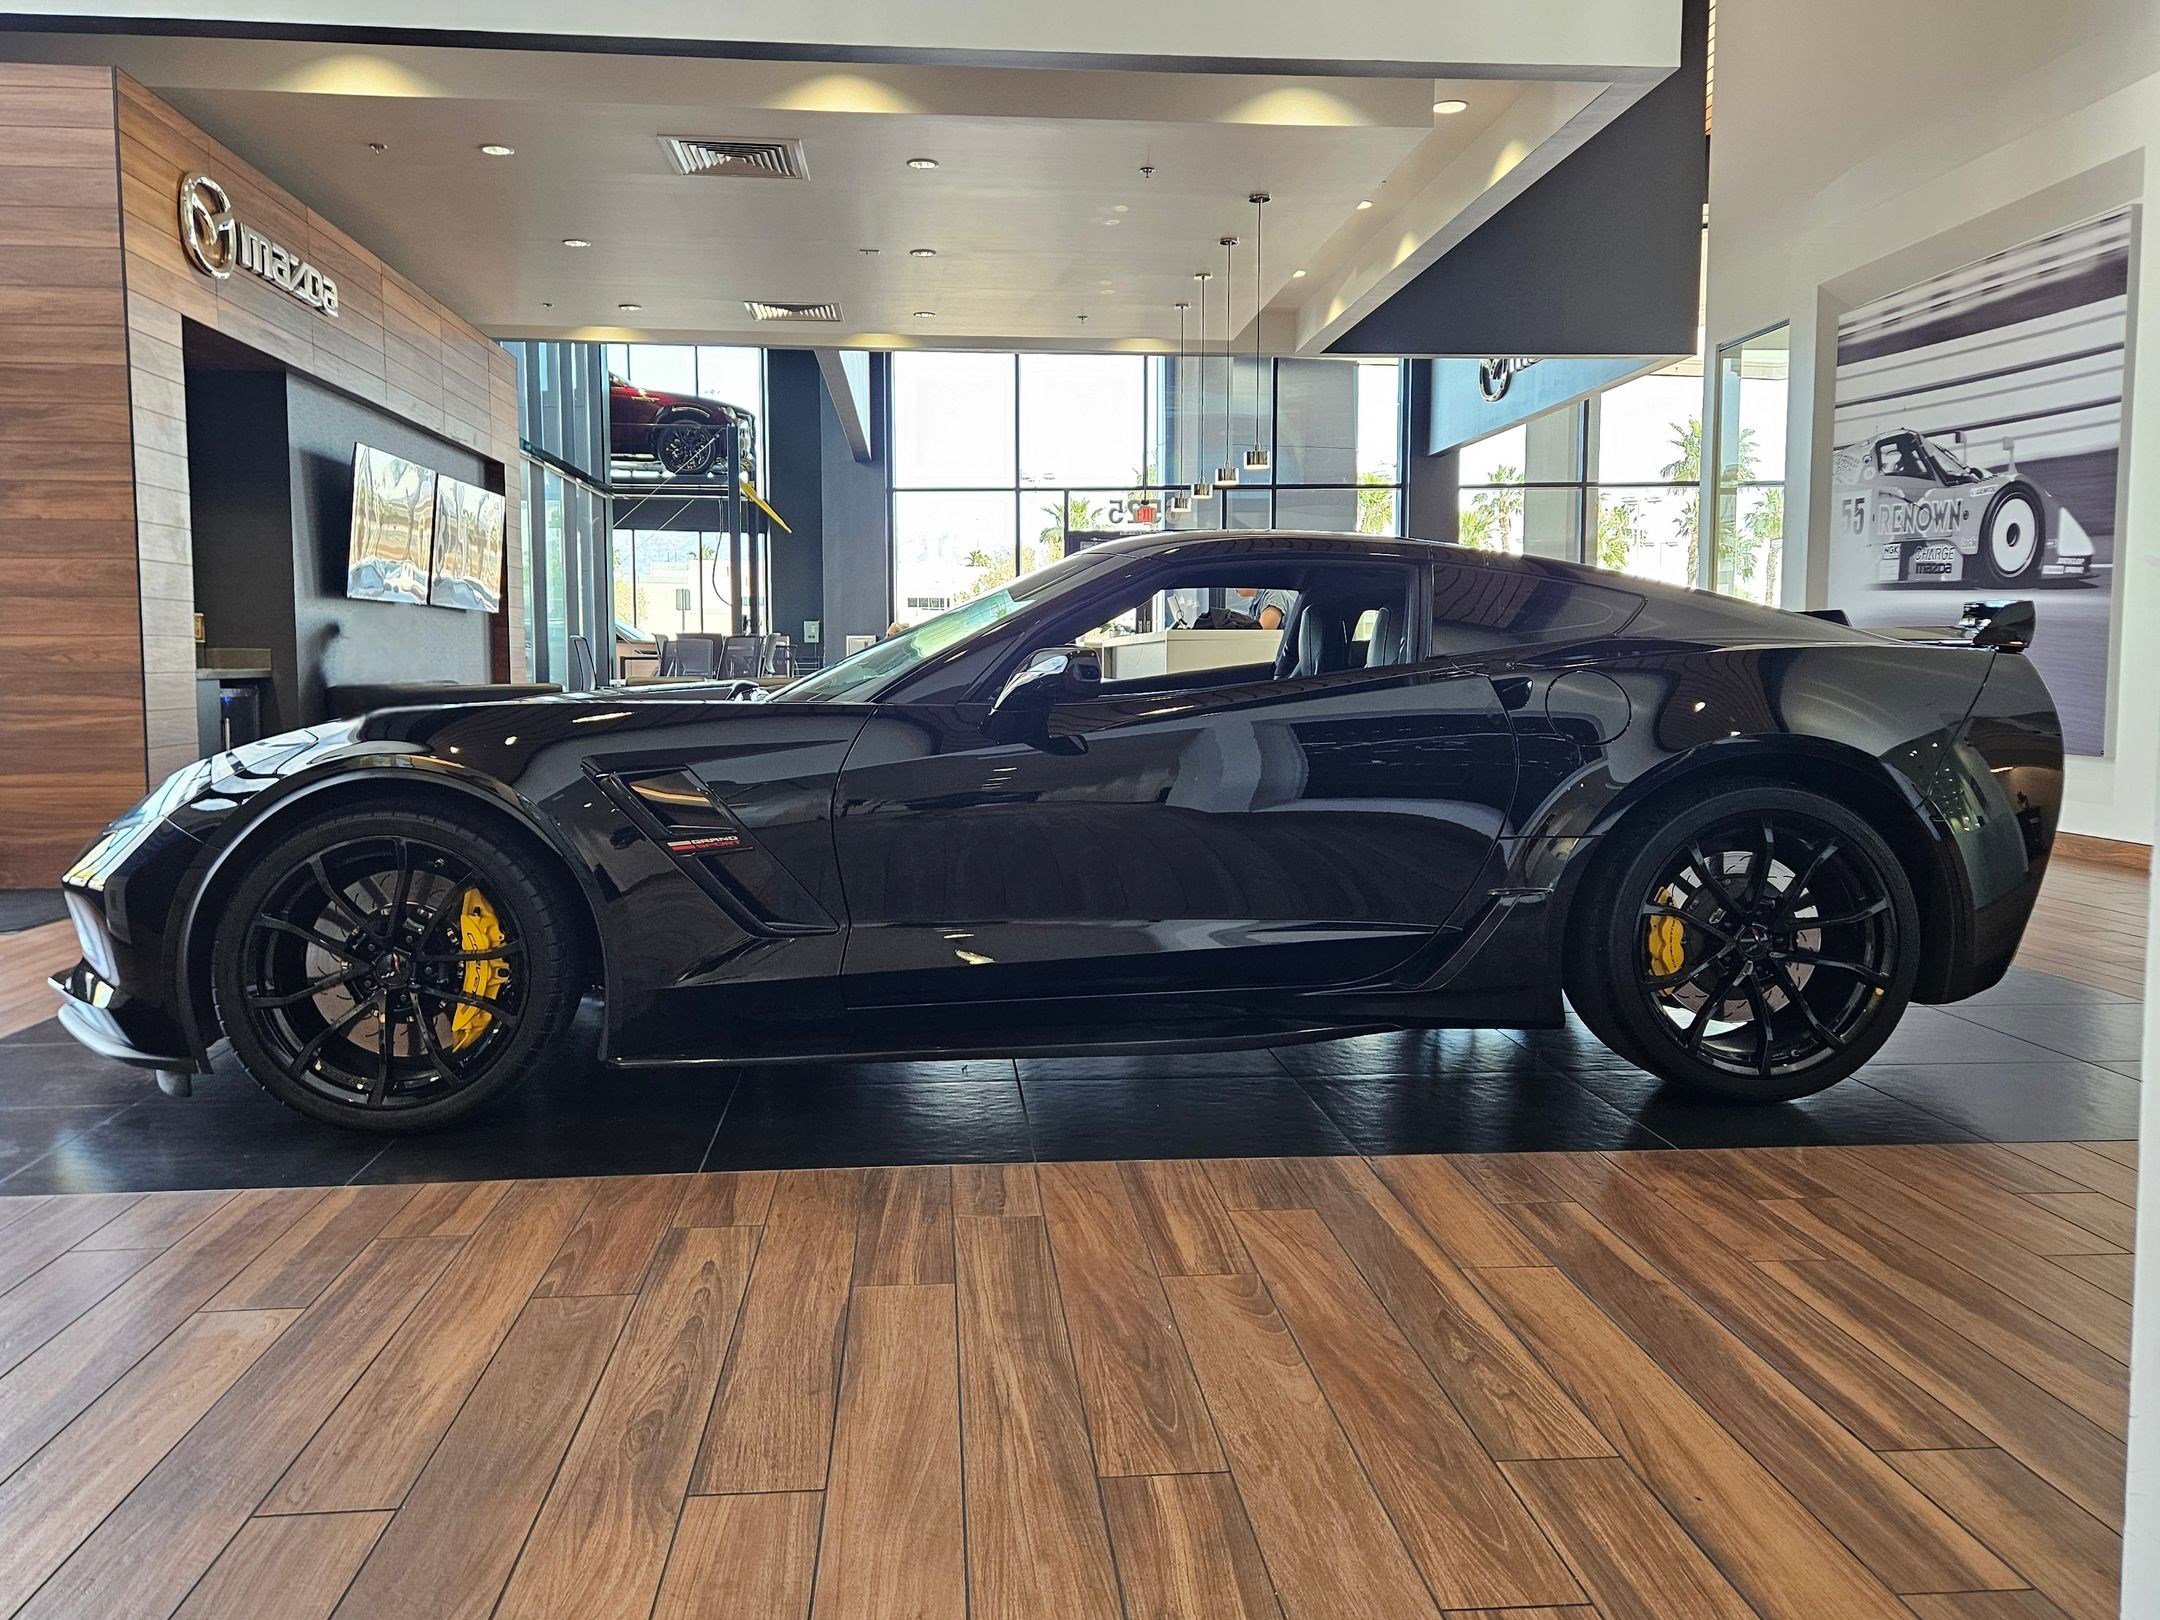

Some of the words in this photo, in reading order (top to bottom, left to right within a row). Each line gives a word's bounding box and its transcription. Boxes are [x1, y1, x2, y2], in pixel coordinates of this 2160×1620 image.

[239, 222, 339, 317] mazda
[1841, 497, 1866, 535] 55
[1877, 499, 1964, 535] RENOWN
[1914, 546, 1956, 561] CHARGE
[691, 835, 739, 845] GRAND
